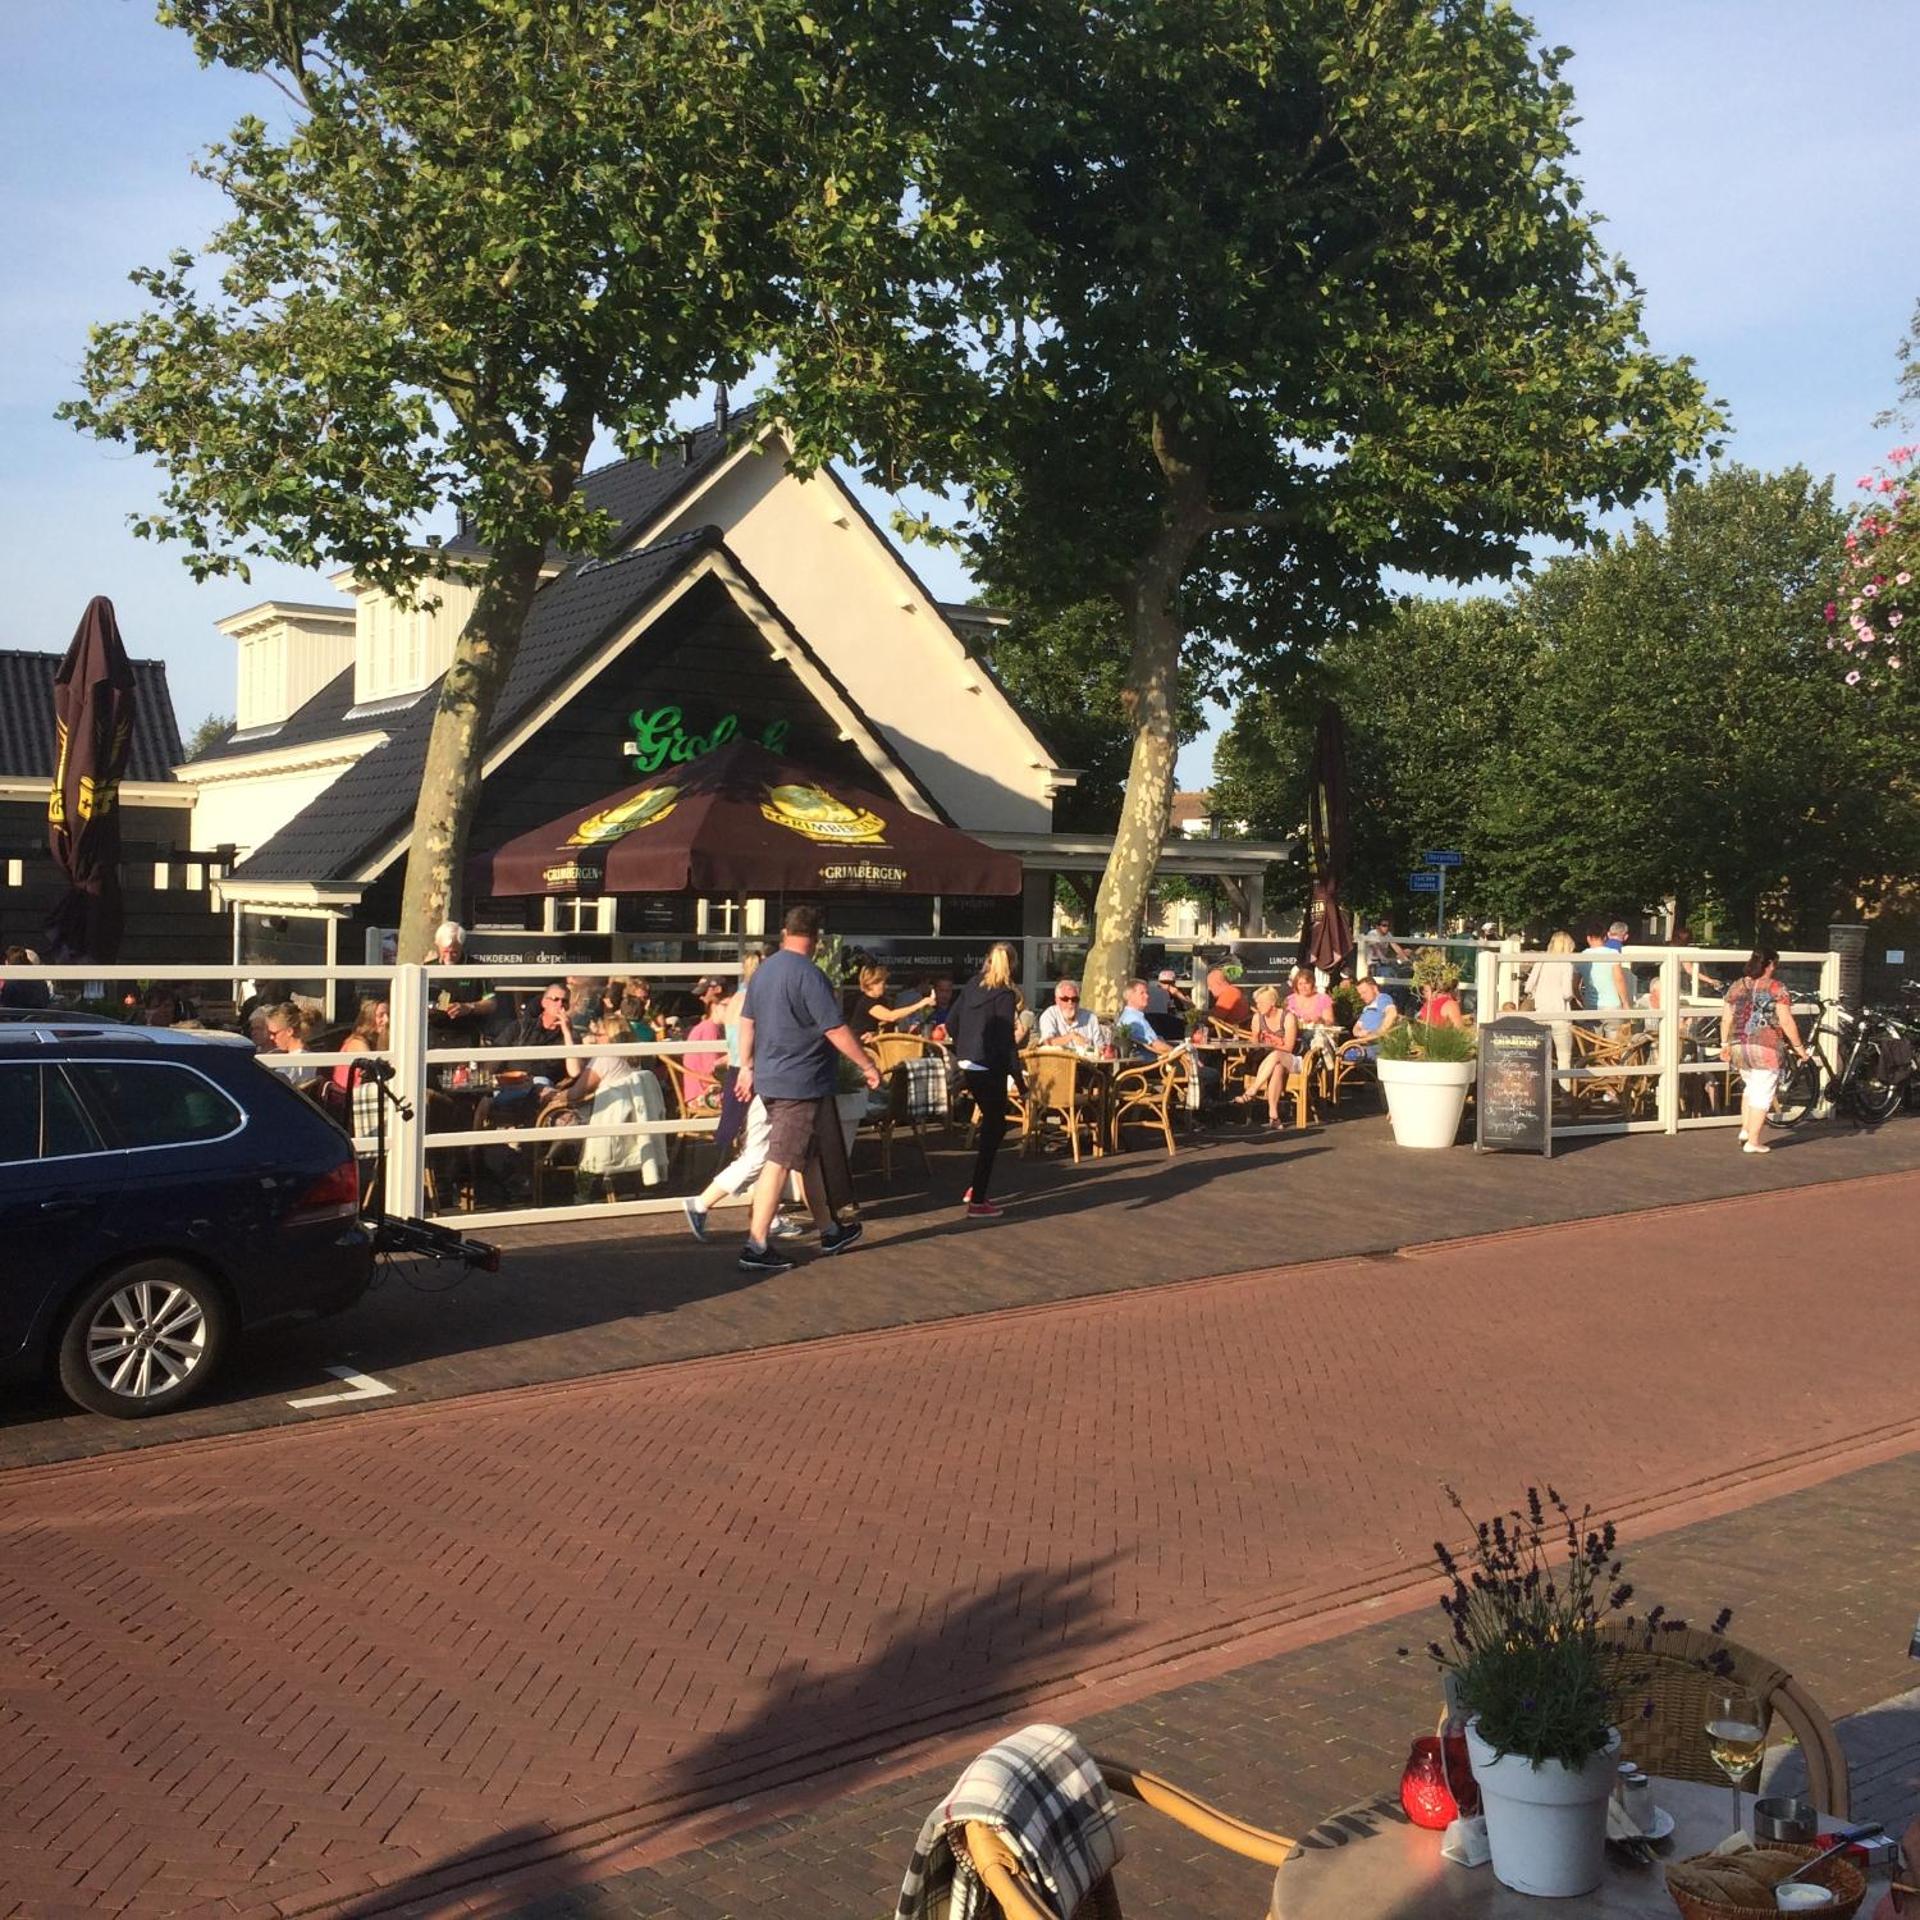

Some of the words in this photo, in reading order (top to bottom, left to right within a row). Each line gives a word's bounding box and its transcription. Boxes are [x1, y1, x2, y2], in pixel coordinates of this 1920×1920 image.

[629, 706, 788, 772] Grolh
[547, 867, 599, 881] GRIMBERGEN
[825, 866, 902, 881] GRIMBERGEN
[471, 953, 523, 964] ENKOEKEN
